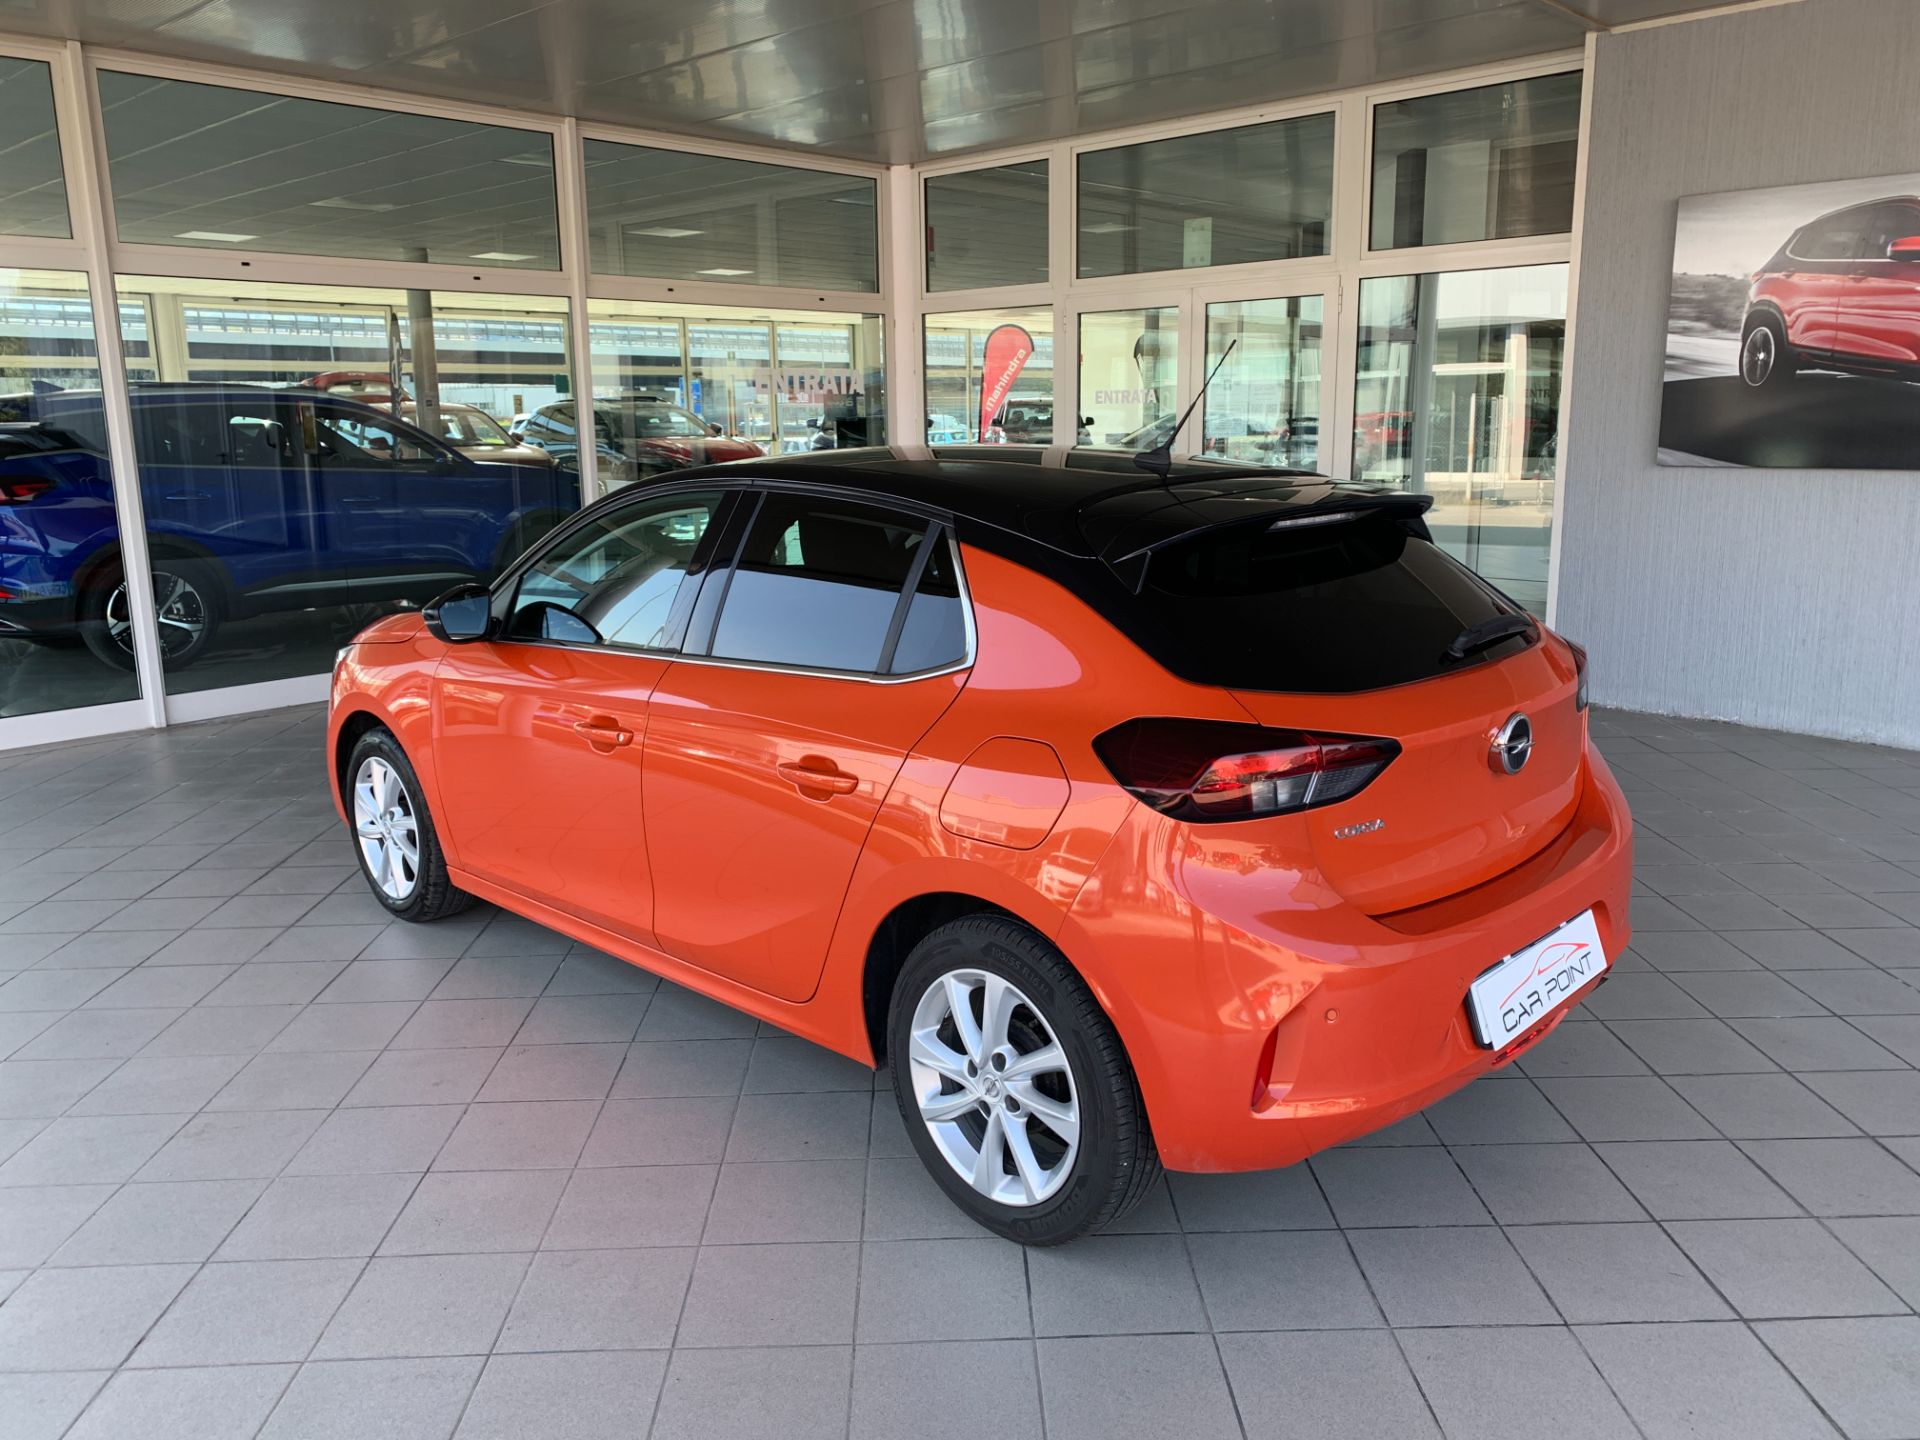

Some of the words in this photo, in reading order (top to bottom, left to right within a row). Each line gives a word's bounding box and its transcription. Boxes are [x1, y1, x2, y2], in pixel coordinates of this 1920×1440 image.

[754, 367, 865, 395] ENTRATA
[1095, 388, 1157, 405] ENTRATA
[1334, 818, 1385, 840] CORSA
[1502, 990, 1544, 1033] CAR
[1544, 951, 1592, 1001] POINT
